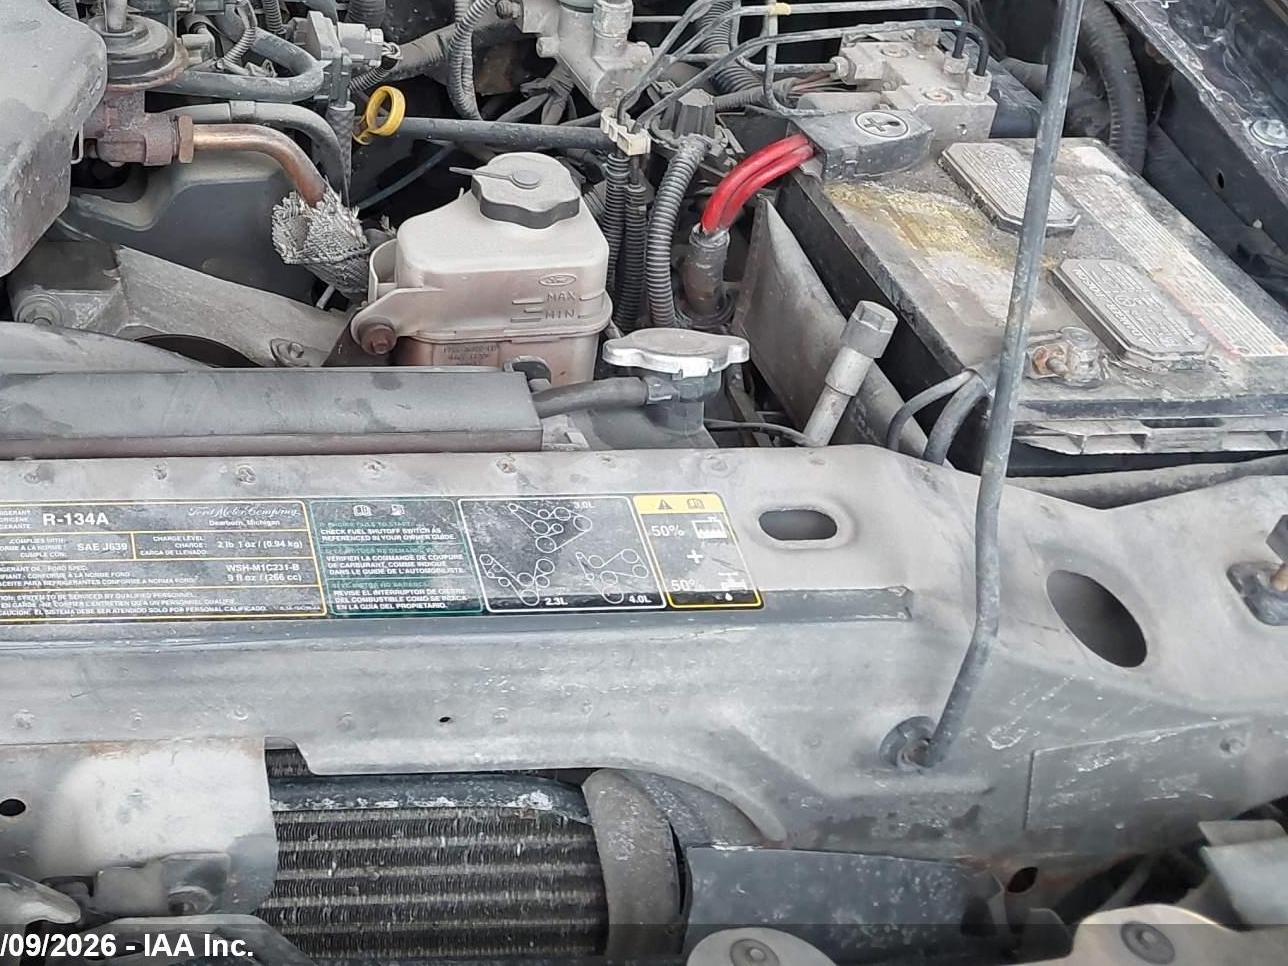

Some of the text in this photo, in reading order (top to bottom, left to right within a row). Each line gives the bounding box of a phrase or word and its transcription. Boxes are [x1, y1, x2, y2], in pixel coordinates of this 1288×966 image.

[546, 291, 576, 301] MAX
[574, 501, 595, 509] 3.0L
[42, 512, 109, 526] R-134A
[246, 519, 280, 527] Michigan
[651, 525, 685, 537] 50%
[77, 542, 128, 551] SAE J639
[288, 540, 303, 550] kg)
[286, 573, 302, 582] cc)
[544, 597, 568, 606] 2.3L
[628, 595, 652, 604] 4.0L
